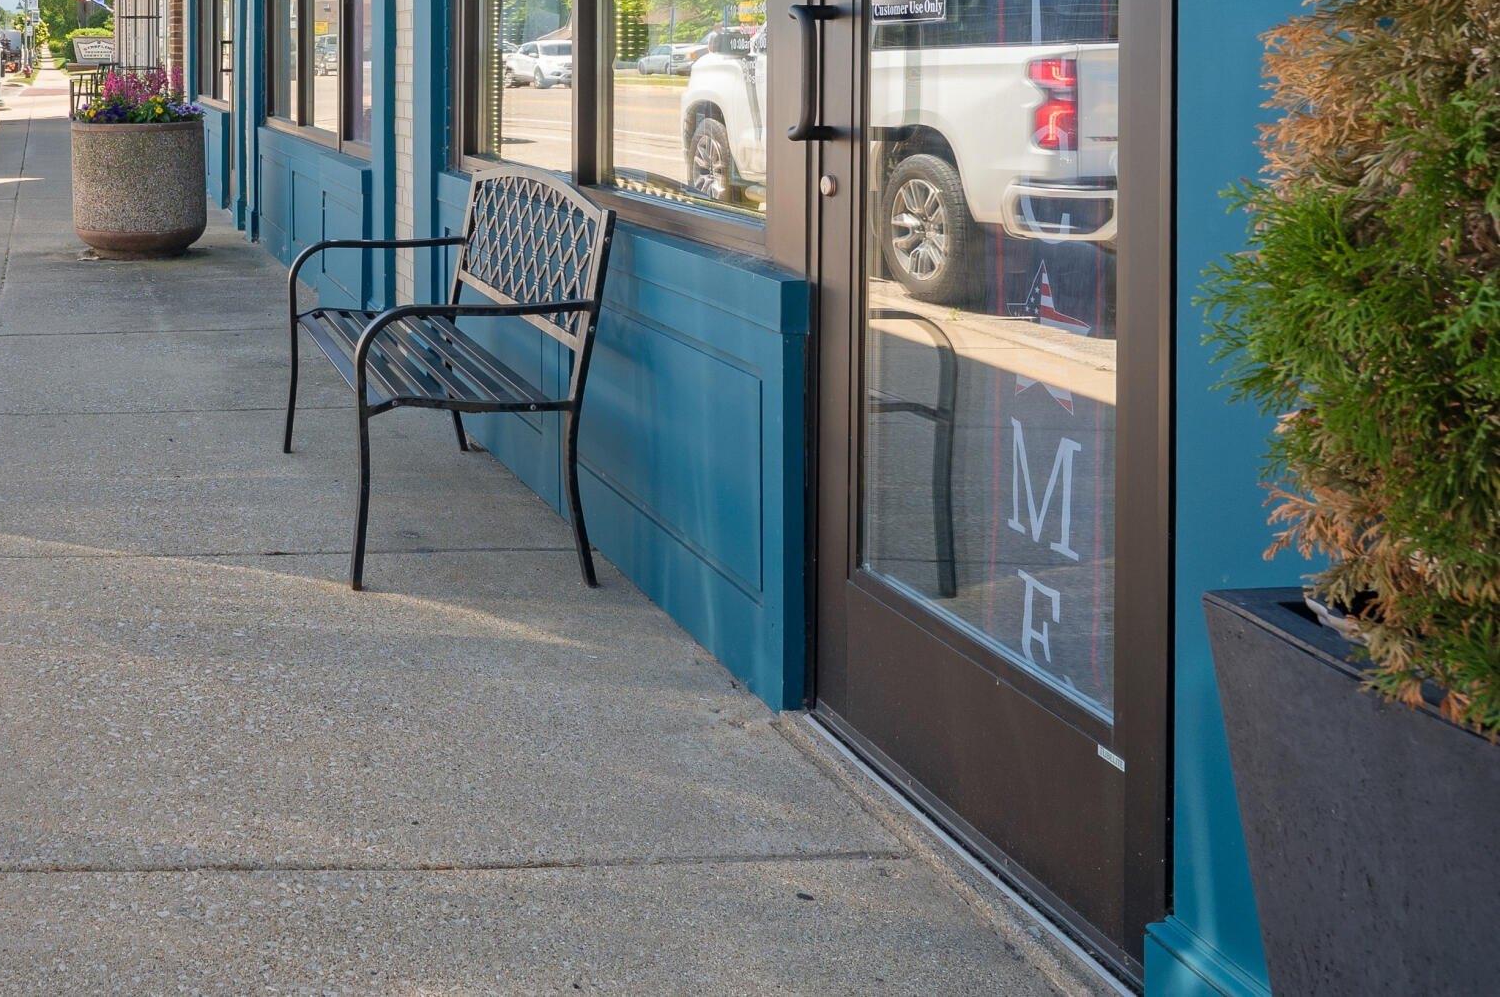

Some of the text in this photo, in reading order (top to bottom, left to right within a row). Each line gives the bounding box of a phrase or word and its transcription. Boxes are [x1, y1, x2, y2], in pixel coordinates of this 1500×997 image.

[874, 0, 943, 16] Customer Use Only
